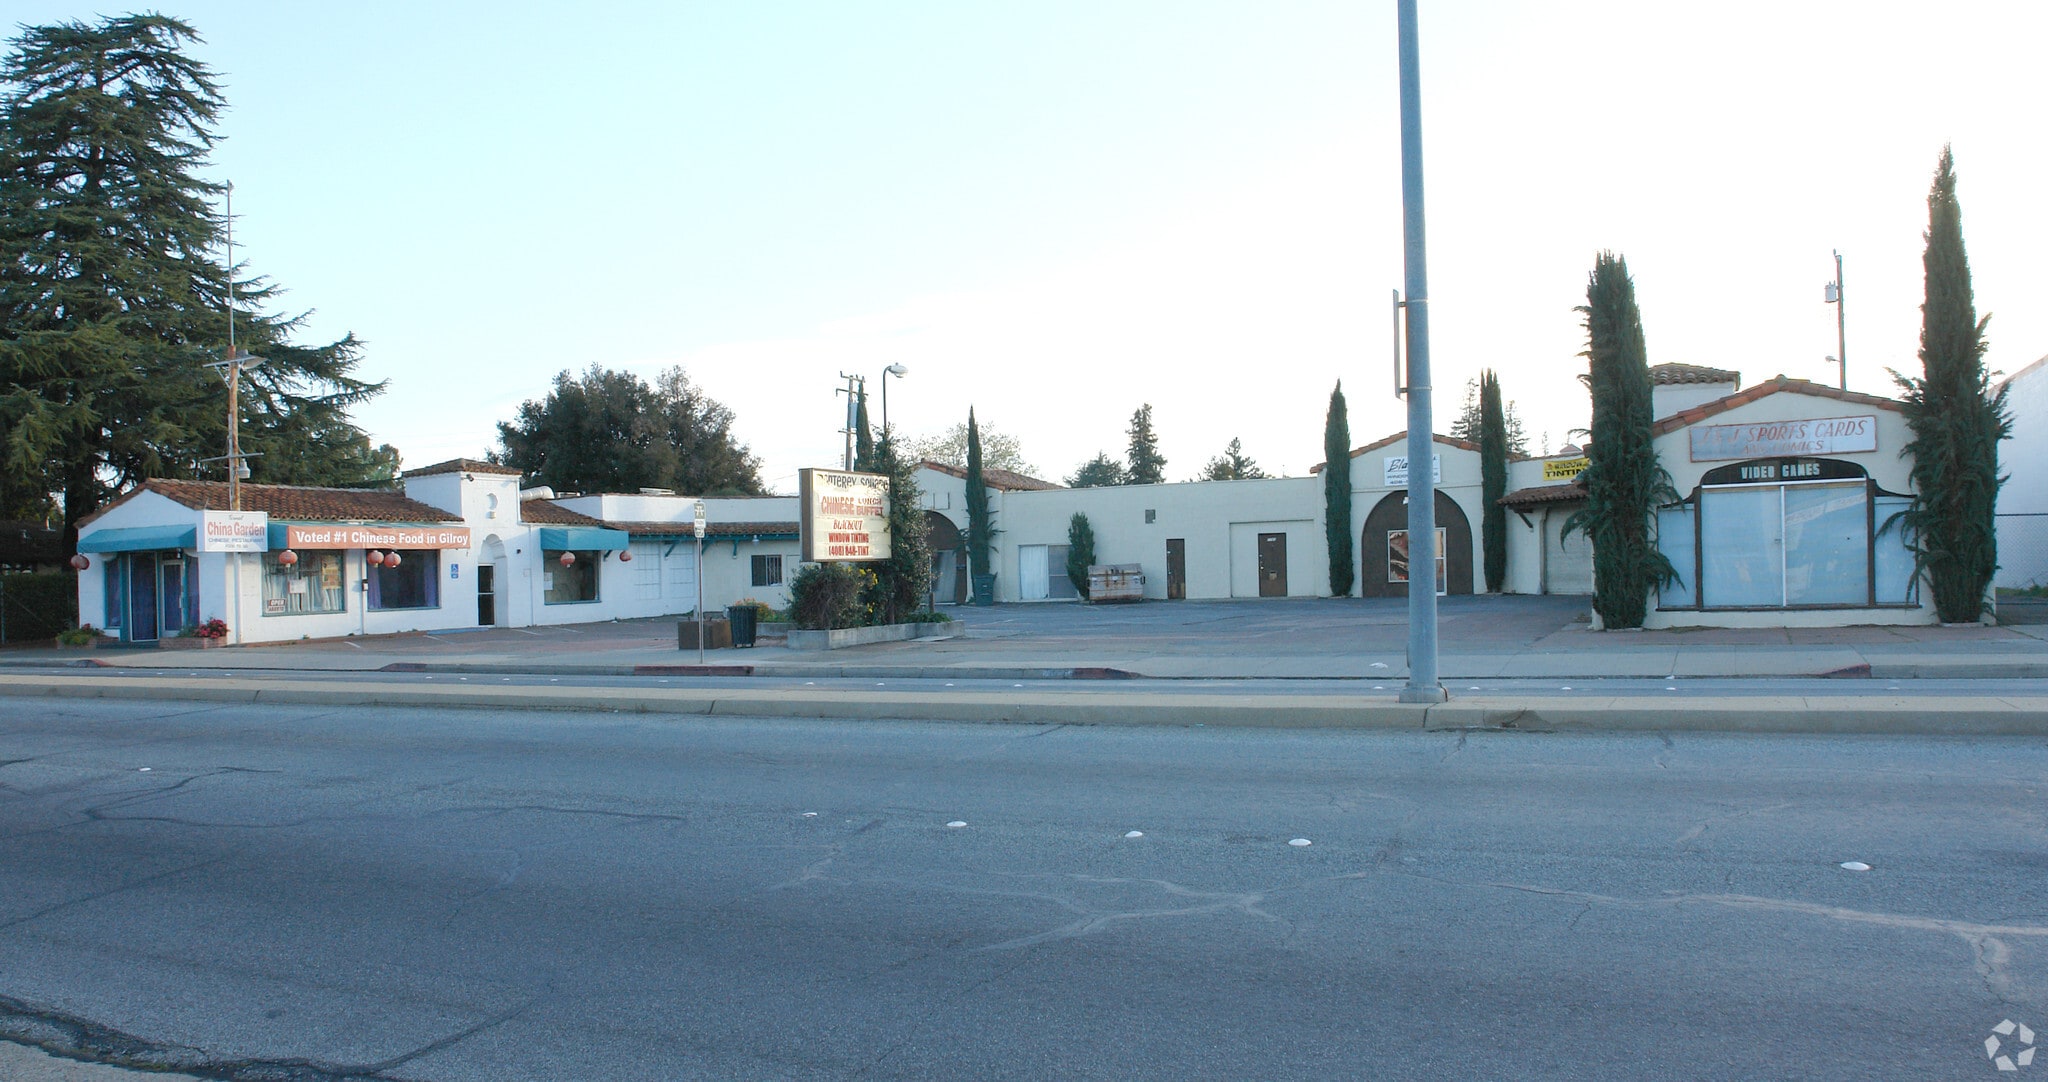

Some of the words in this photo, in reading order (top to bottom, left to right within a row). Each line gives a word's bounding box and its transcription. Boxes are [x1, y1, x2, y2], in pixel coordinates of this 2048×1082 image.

[1745, 424, 1808, 442] SPORTS
[1814, 420, 1868, 438] CARDS
[1741, 466, 1775, 480] VIDEO
[1782, 463, 1820, 478] GAMES
[207, 521, 233, 536] China
[233, 521, 265, 536] Garden
[296, 531, 330, 543] Voted
[333, 532, 347, 543] #1
[351, 531, 396, 544] Chinese
[399, 532, 424, 544] Food
[427, 532, 436, 544] in
[439, 532, 468, 546] Gilroy
[828, 532, 850, 543] WINDOW
